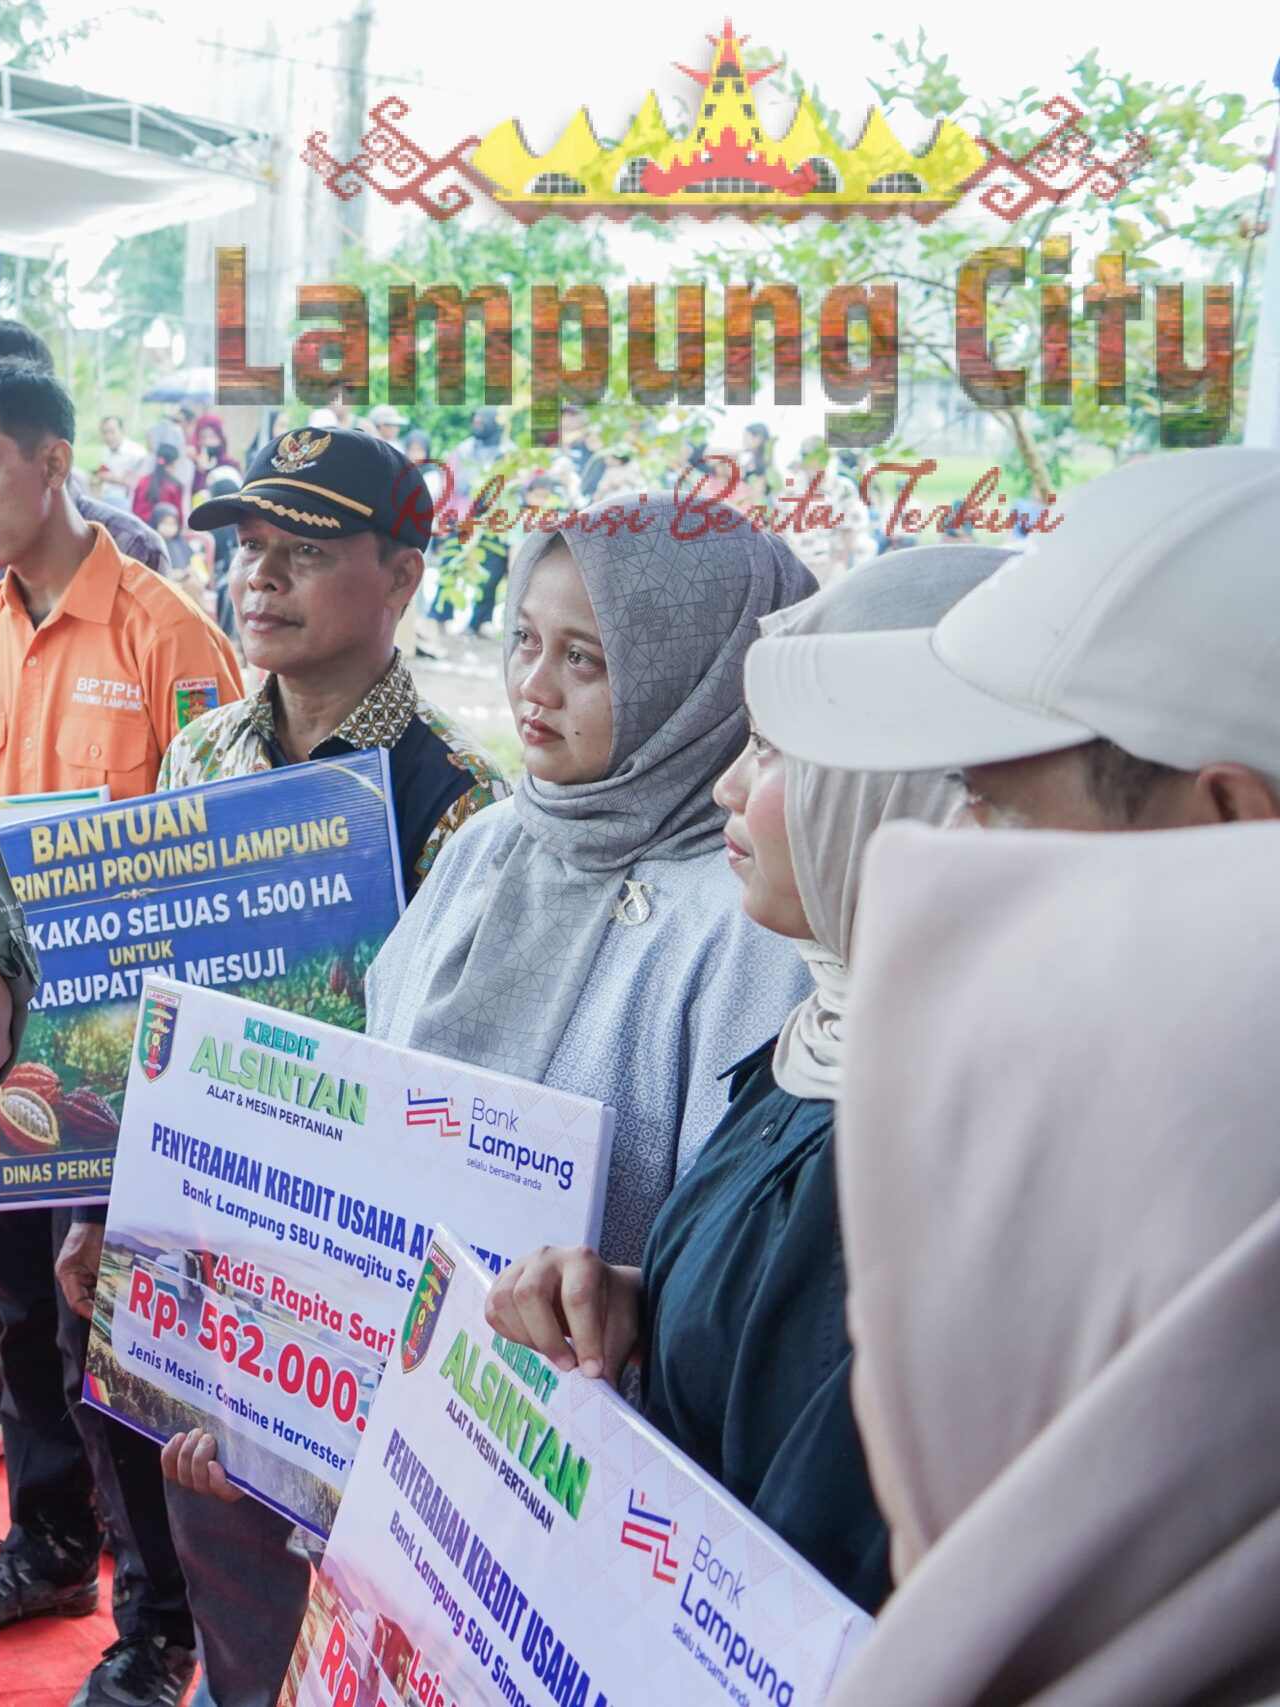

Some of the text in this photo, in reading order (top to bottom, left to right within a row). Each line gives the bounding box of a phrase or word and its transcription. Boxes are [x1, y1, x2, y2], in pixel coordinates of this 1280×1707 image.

[76, 677, 141, 699] BPTPH
[11, 815, 350, 902] RINTAH PROVINSI LAMPUNG
[31, 794, 208, 865] BANTUAN
[27, 872, 352, 951] KAKAO SELUAS 1.500 HA
[109, 940, 175, 967] UNTUK
[185, 947, 287, 986] MESUJI
[243, 1017, 320, 1061] KREDIT
[189, 1033, 368, 1125] ALSINTAN
[206, 1084, 343, 1142] ALAT & MESIN PERTANIAN
[472, 1097, 520, 1133] Bank
[2, 1157, 115, 1185] DINAS PERKE
[151, 1122, 262, 1194] PENYERAHAN
[264, 1165, 335, 1222] KREDIT
[337, 1193, 406, 1253] USAHA
[466, 1157, 542, 1191] selalu bersama anda
[469, 1123, 574, 1190] Lampung
[182, 1179, 212, 1208] Bank
[216, 1194, 286, 1241] Lampung
[289, 1223, 320, 1251] SBU
[323, 1237, 393, 1284] Rawajitu
[214, 1254, 396, 1357] Adis Rapita Sari
[128, 1267, 366, 1433] Rp. 562.000.
[128, 1341, 161, 1370] Jenis
[165, 1357, 205, 1392] Mesin
[215, 1384, 269, 1430] Combine
[272, 1417, 347, 1472] Harvester
[439, 1328, 592, 1521] ALSINTAN
[446, 1399, 555, 1533] ALAT & MESIN PERTANIAN
[383, 1427, 591, 1707] PENYERAHAN KREDIT USAHA
[692, 1534, 746, 1611] Bank
[389, 1510, 531, 1707] Bank Lampung SBU Simp
